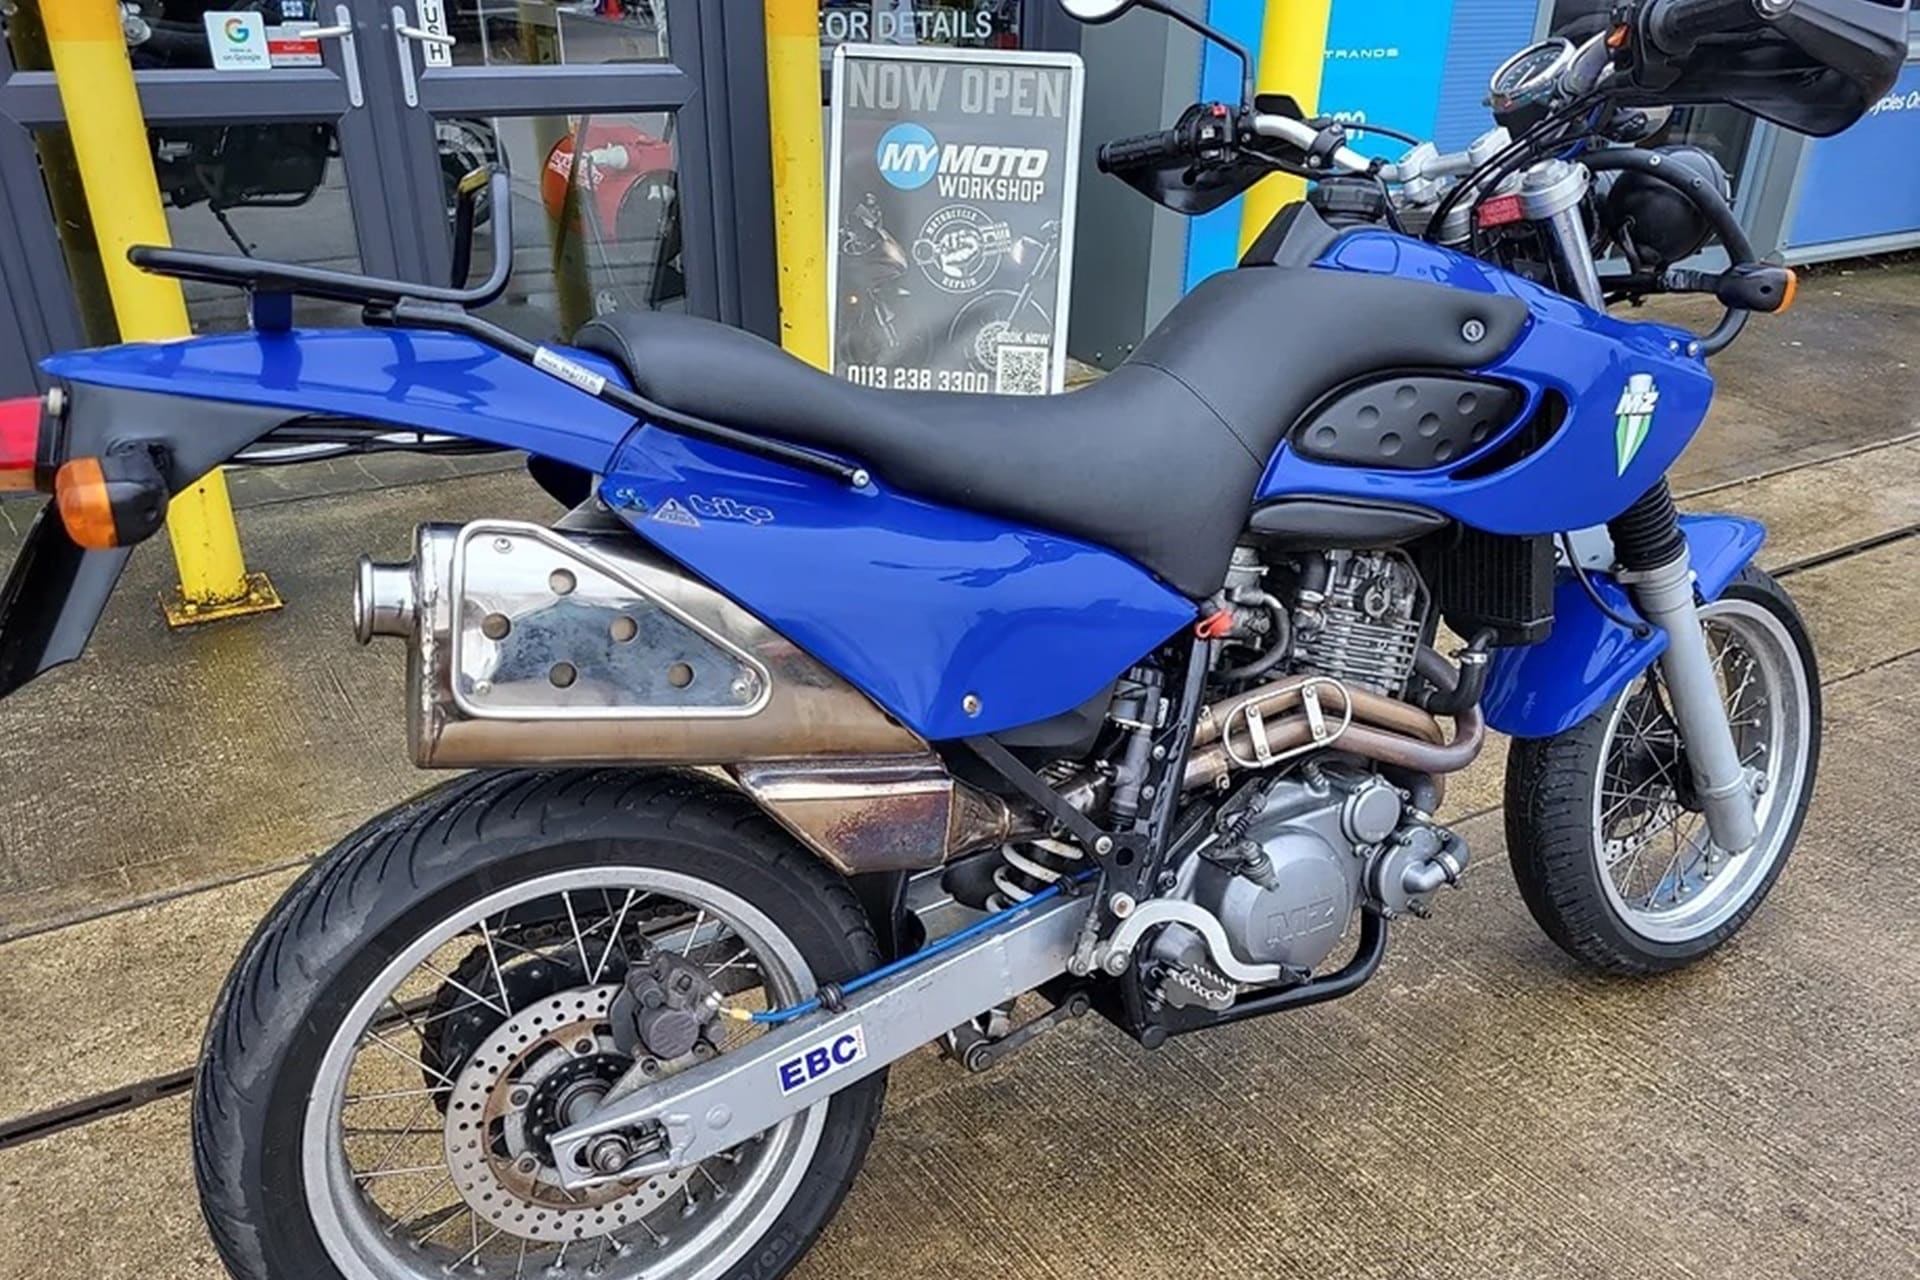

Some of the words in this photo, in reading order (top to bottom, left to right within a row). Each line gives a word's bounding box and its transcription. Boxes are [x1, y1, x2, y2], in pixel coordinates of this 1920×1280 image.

[423, 0, 444, 60] USH
[879, 11, 993, 38] DETAILS
[1323, 48, 1399, 58] TRANDS
[849, 62, 946, 111] NOW
[960, 67, 1064, 118] OPEN
[880, 142, 939, 172] MY
[939, 144, 1048, 178] MOTO
[937, 175, 1045, 202] WORKSHOP
[848, 364, 887, 389] 0113
[894, 368, 931, 390] 238
[938, 371, 989, 393] 3300
[779, 1034, 857, 1092] EBC
